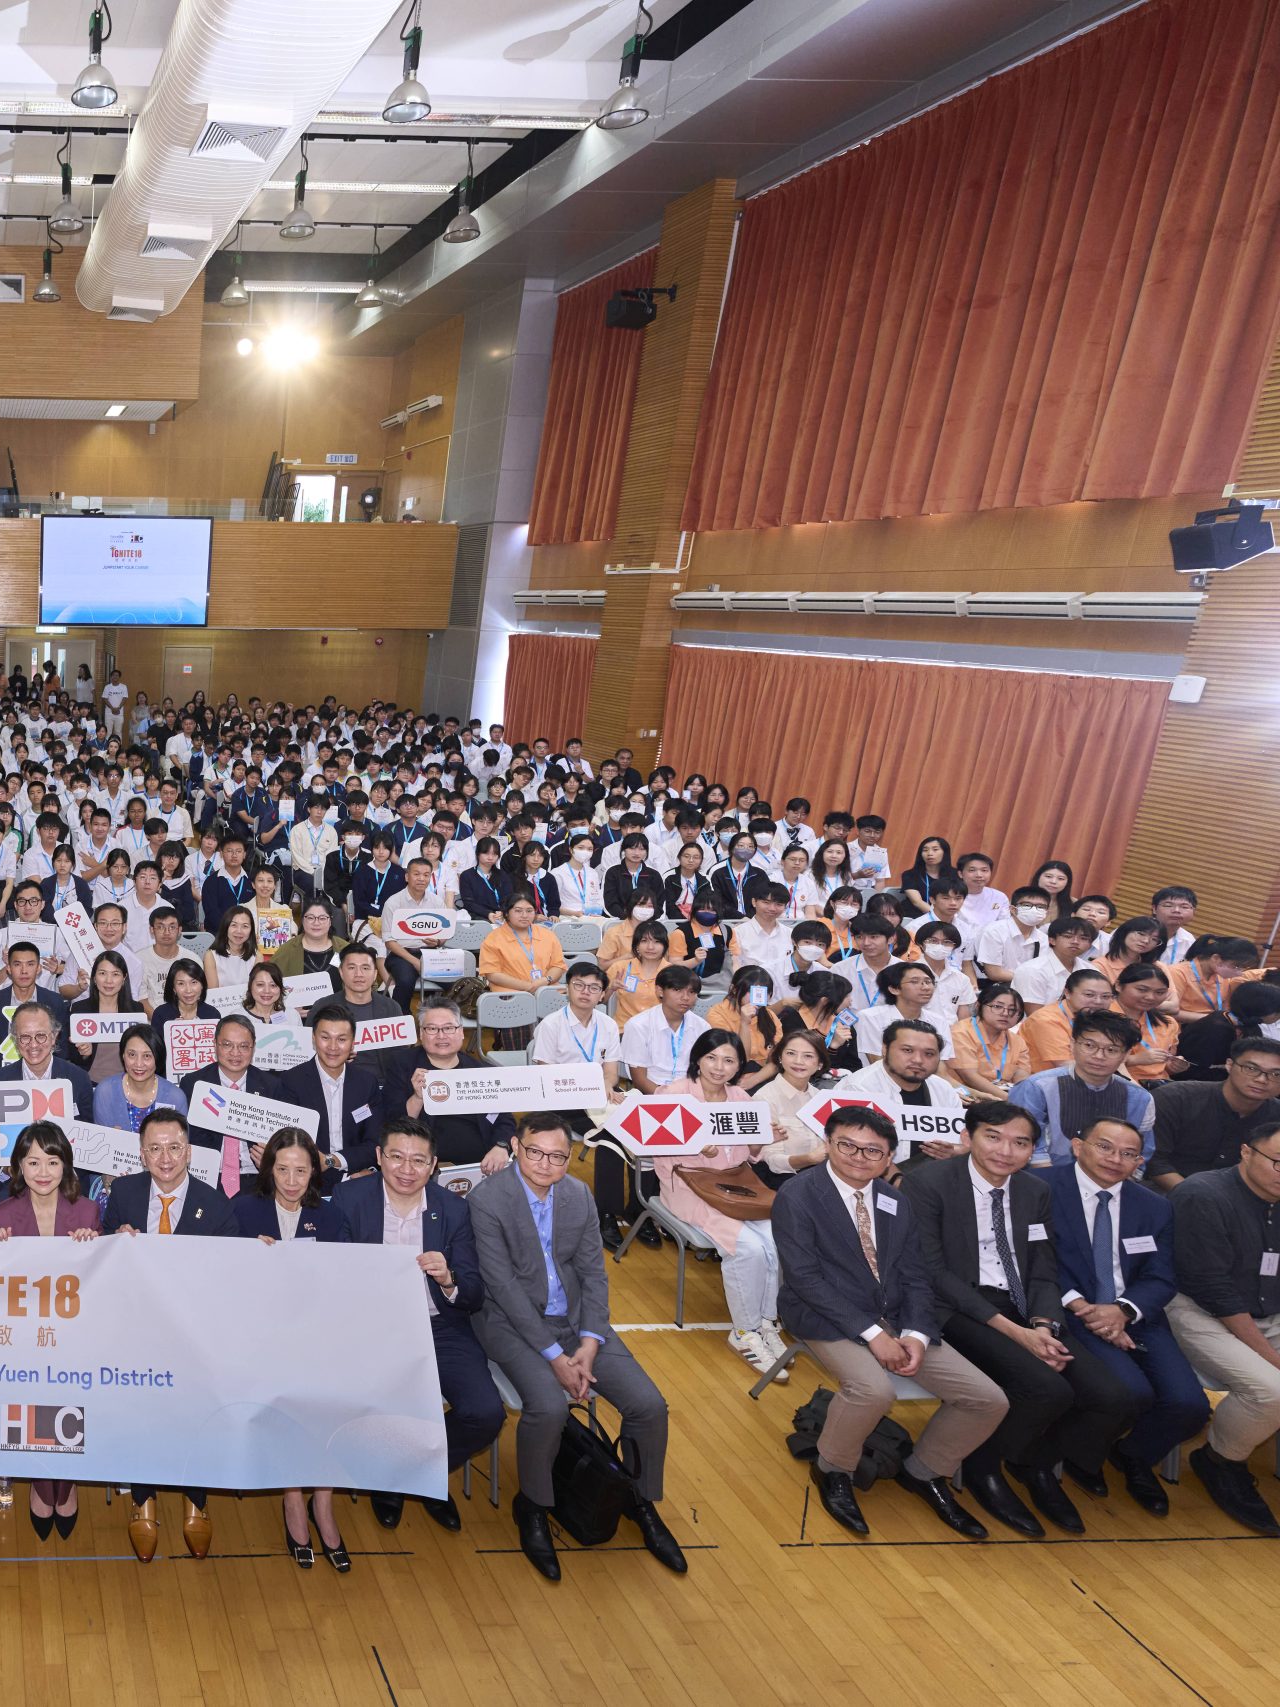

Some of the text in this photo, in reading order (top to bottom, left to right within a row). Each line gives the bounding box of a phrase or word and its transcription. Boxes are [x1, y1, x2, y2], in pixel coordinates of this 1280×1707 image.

[100, 1022, 140, 1033] MT
[228, 1108, 264, 1122] Information
[230, 1101, 247, 1111] Hong
[248, 1105, 265, 1116] Kong
[266, 1110, 291, 1122] Institute
[901, 1113, 967, 1135] HSBC
[47, 1366, 92, 1390] Long
[100, 1367, 174, 1387] District
